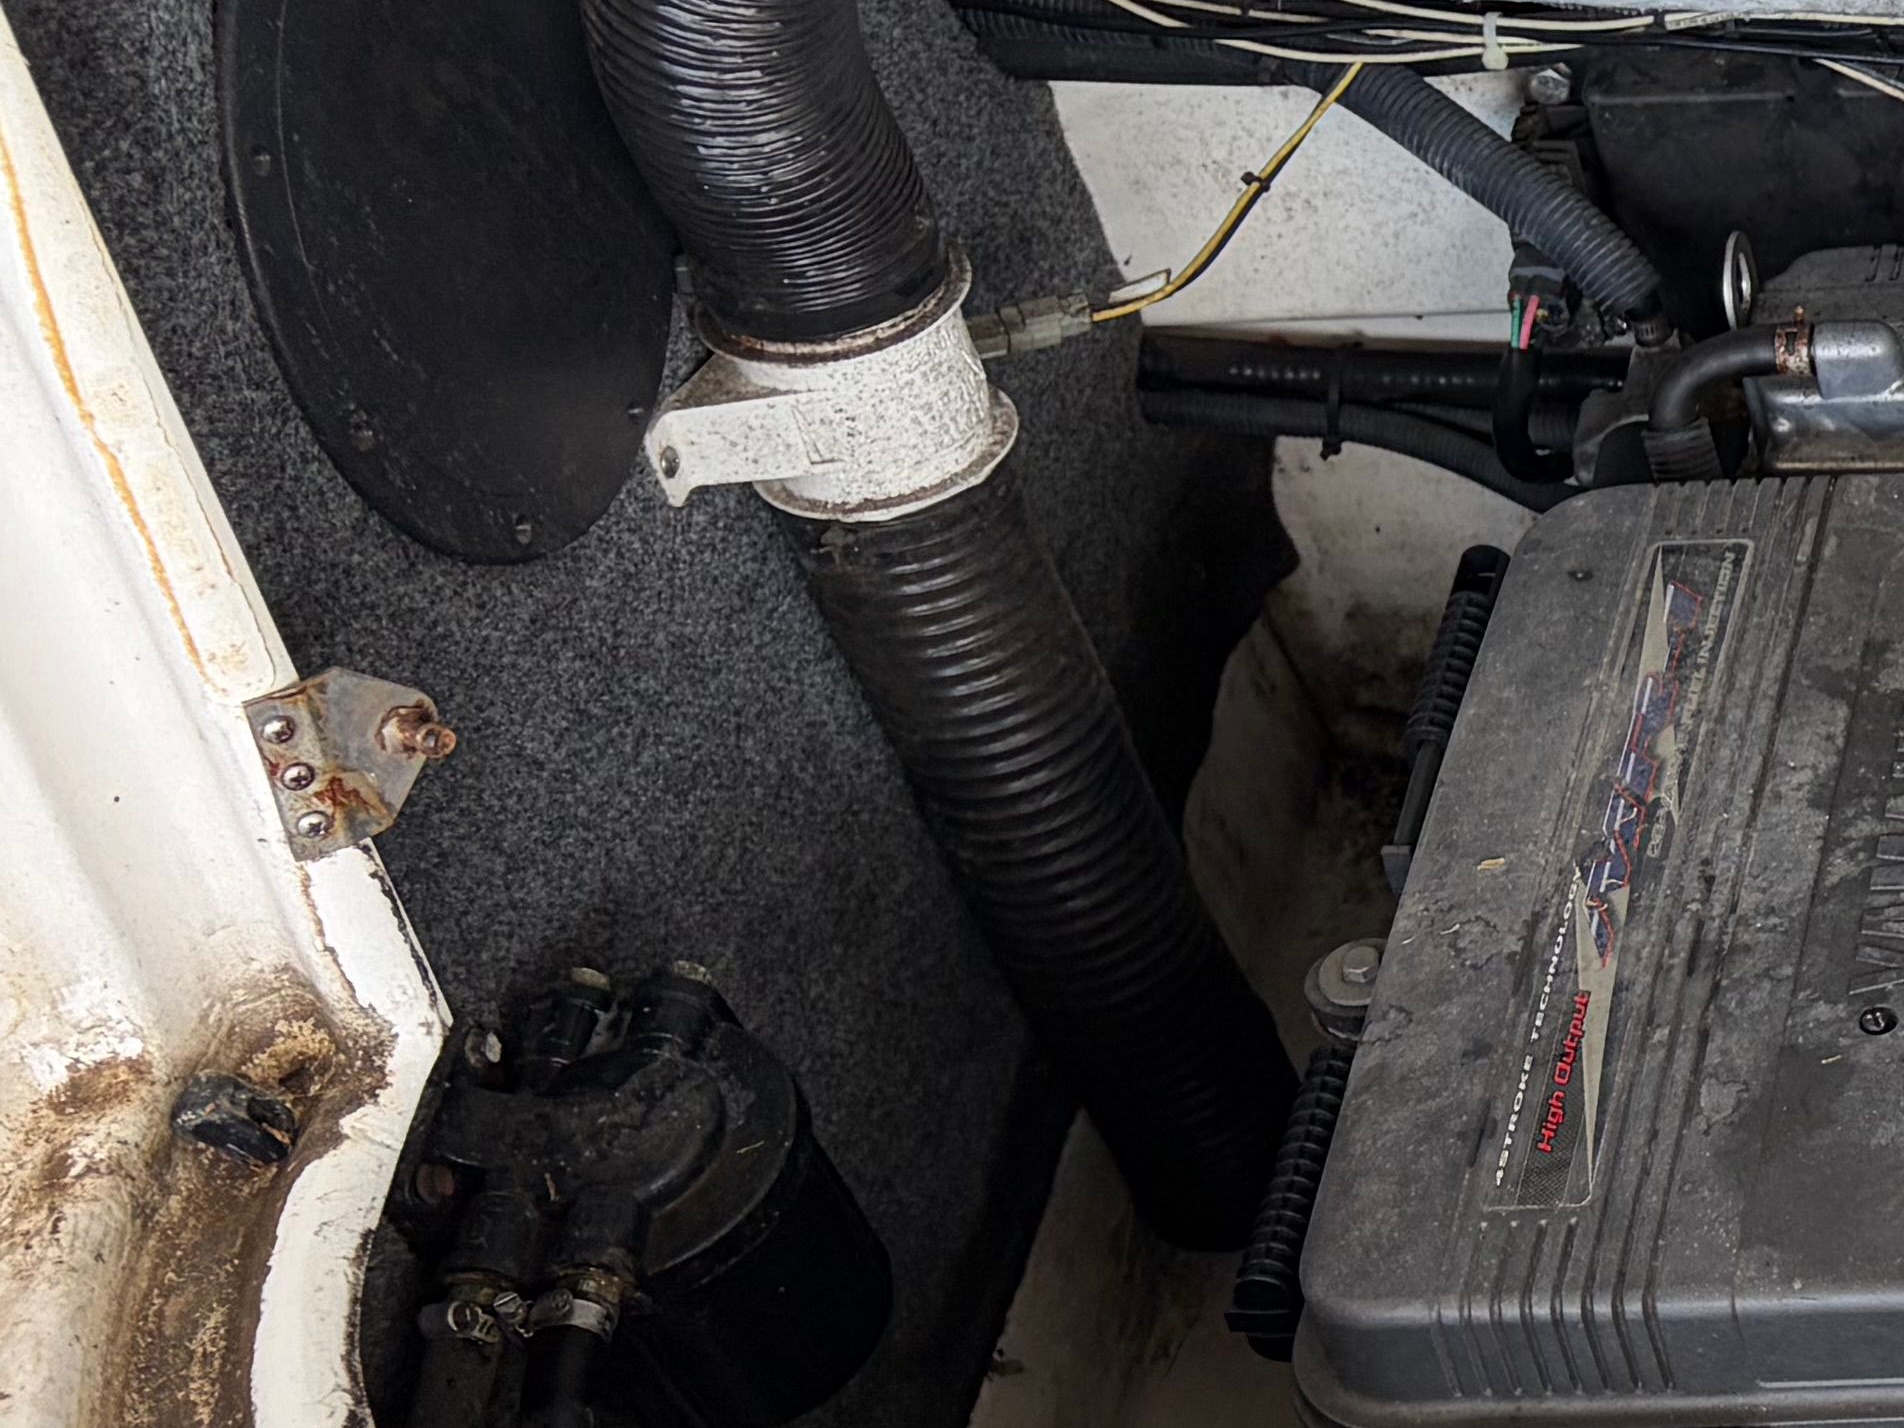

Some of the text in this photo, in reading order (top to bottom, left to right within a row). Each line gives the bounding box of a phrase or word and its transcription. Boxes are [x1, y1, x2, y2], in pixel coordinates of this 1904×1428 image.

[1696, 551, 1736, 668] INJECTION
[1496, 858, 1582, 1187] 4STROKE TECHNOLOGY
[1536, 990, 1592, 1154] High Output
